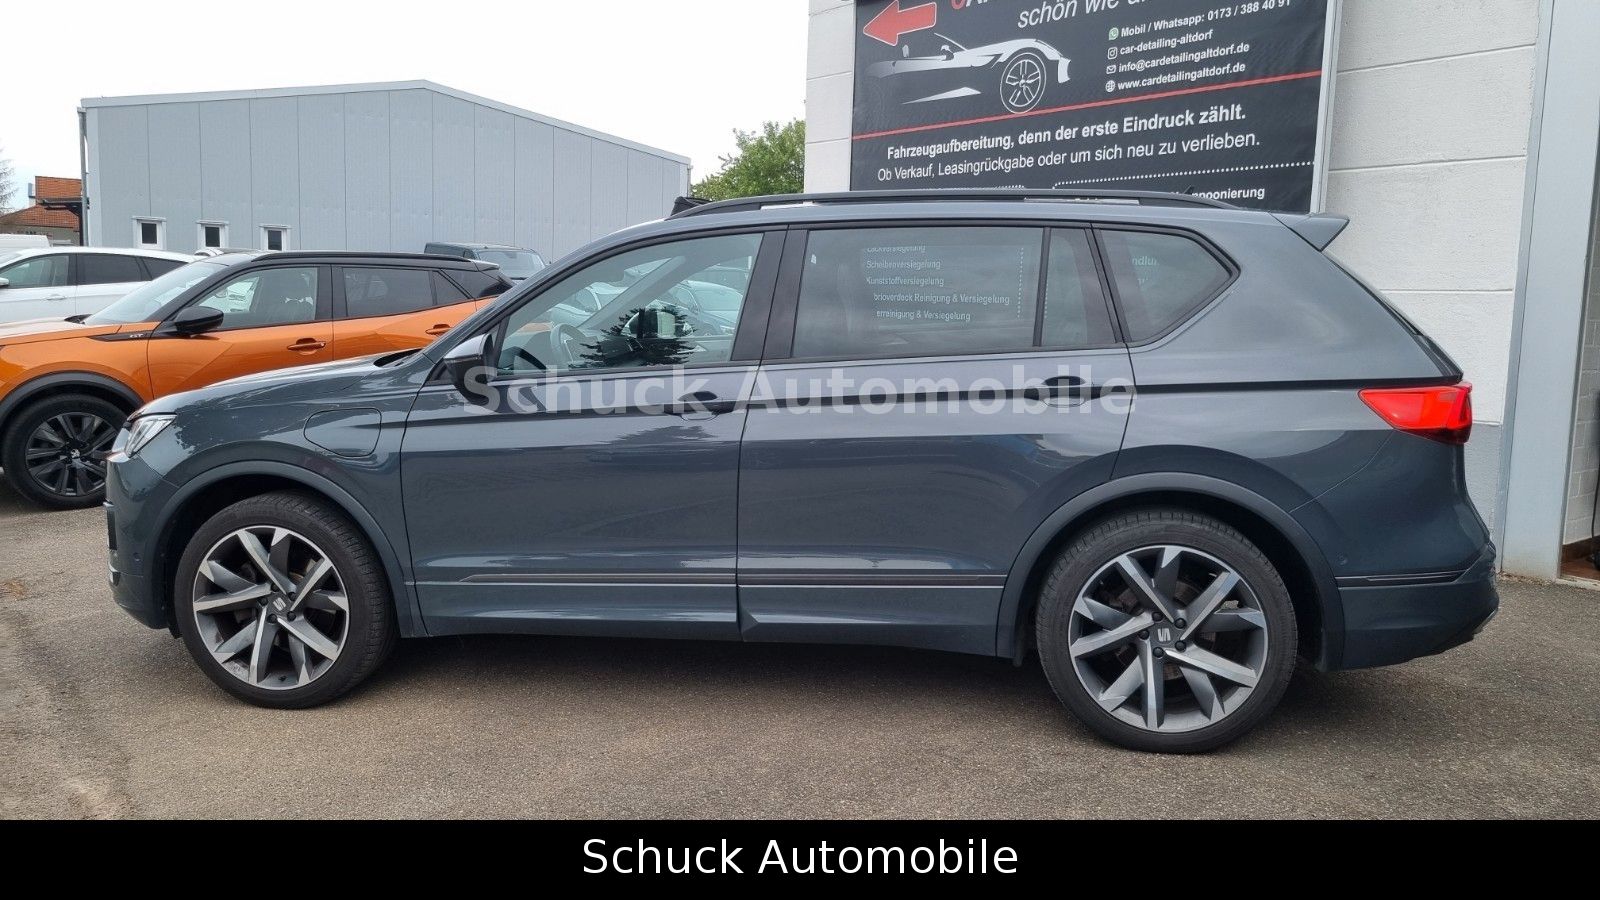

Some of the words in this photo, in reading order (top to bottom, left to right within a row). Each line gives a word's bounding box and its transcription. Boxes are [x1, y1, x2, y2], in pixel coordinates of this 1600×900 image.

[1017, 0, 1078, 28] schön
[1121, 25, 1146, 38] Mobil
[1154, 14, 1205, 31] Whatsapp:
[1207, 7, 1232, 21] 0173
[1240, 2, 1260, 15] 388
[1262, 0, 1275, 10] 40
[1120, 29, 1214, 56] car-detailing-altdorf
[1118, 42, 1250, 73] info@cardetailingaltdorf.de
[1118, 62, 1246, 91] www.cardetailingaltdorf.de
[887, 135, 1014, 160] Fahrzeugaufbereitung,
[1018, 128, 1051, 145] denn
[1055, 125, 1078, 141] der
[1081, 120, 1118, 138] erste
[1123, 109, 1194, 133] Eindruck
[1199, 103, 1246, 124] zählt.
[877, 168, 892, 181] Ob
[894, 163, 935, 180] Verkauf,
[938, 154, 1034, 176] Leasingrückgabe
[1037, 151, 1067, 167] oder
[1070, 150, 1091, 163] um
[1095, 144, 1122, 161] sich
[1127, 144, 1154, 158] neu
[1158, 141, 1176, 155] zu
[1181, 132, 1261, 153] verlieben.
[914, 293, 950, 304] Reinigung
[952, 294, 958, 302] &
[959, 294, 1010, 305] Versiegelung
[916, 310, 921, 318] &
[923, 310, 971, 321] Versiegelung
